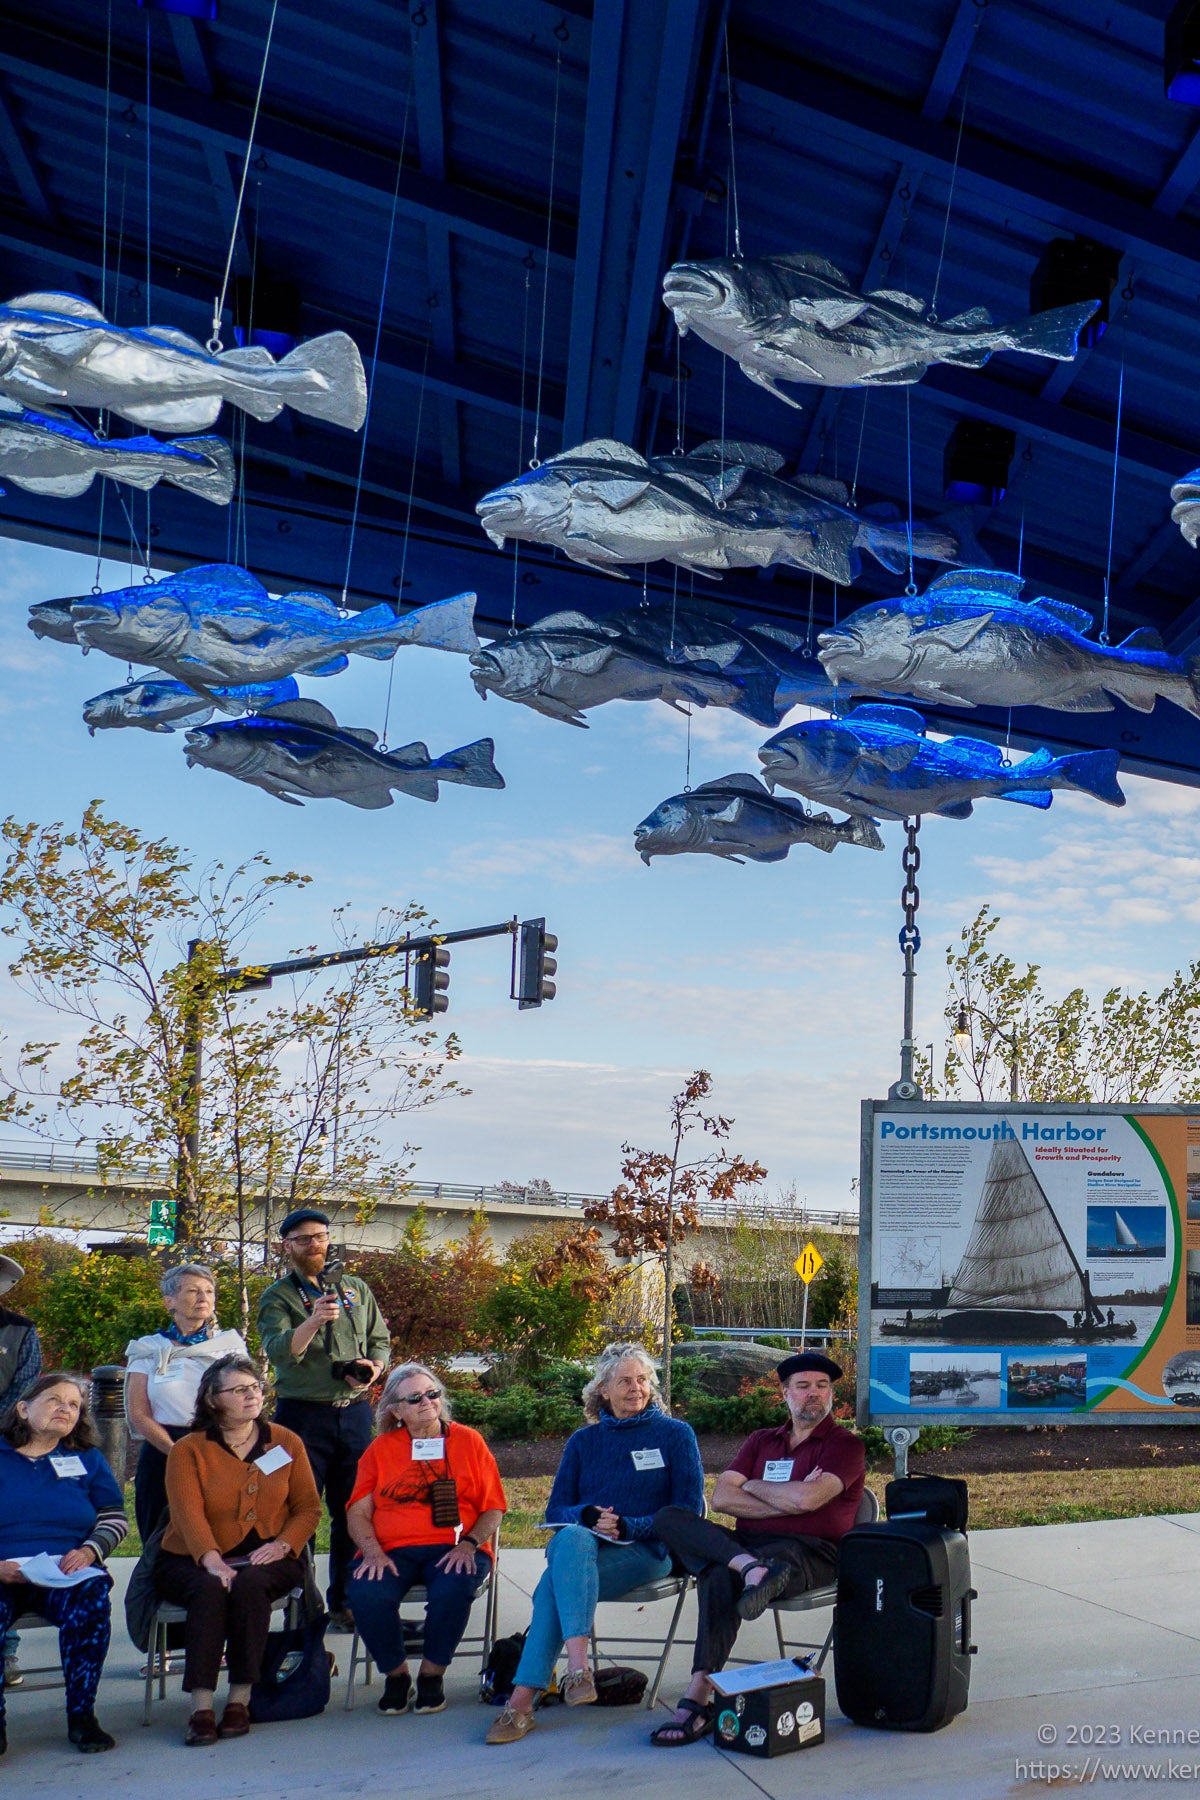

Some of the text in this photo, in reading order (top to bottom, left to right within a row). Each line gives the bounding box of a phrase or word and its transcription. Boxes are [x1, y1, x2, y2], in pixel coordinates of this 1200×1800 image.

[880, 1121, 1107, 1141] Portsmouth Harbor
[1035, 1146, 1062, 1155] Ideally
[1082, 1154, 1122, 1163] Prosperity
